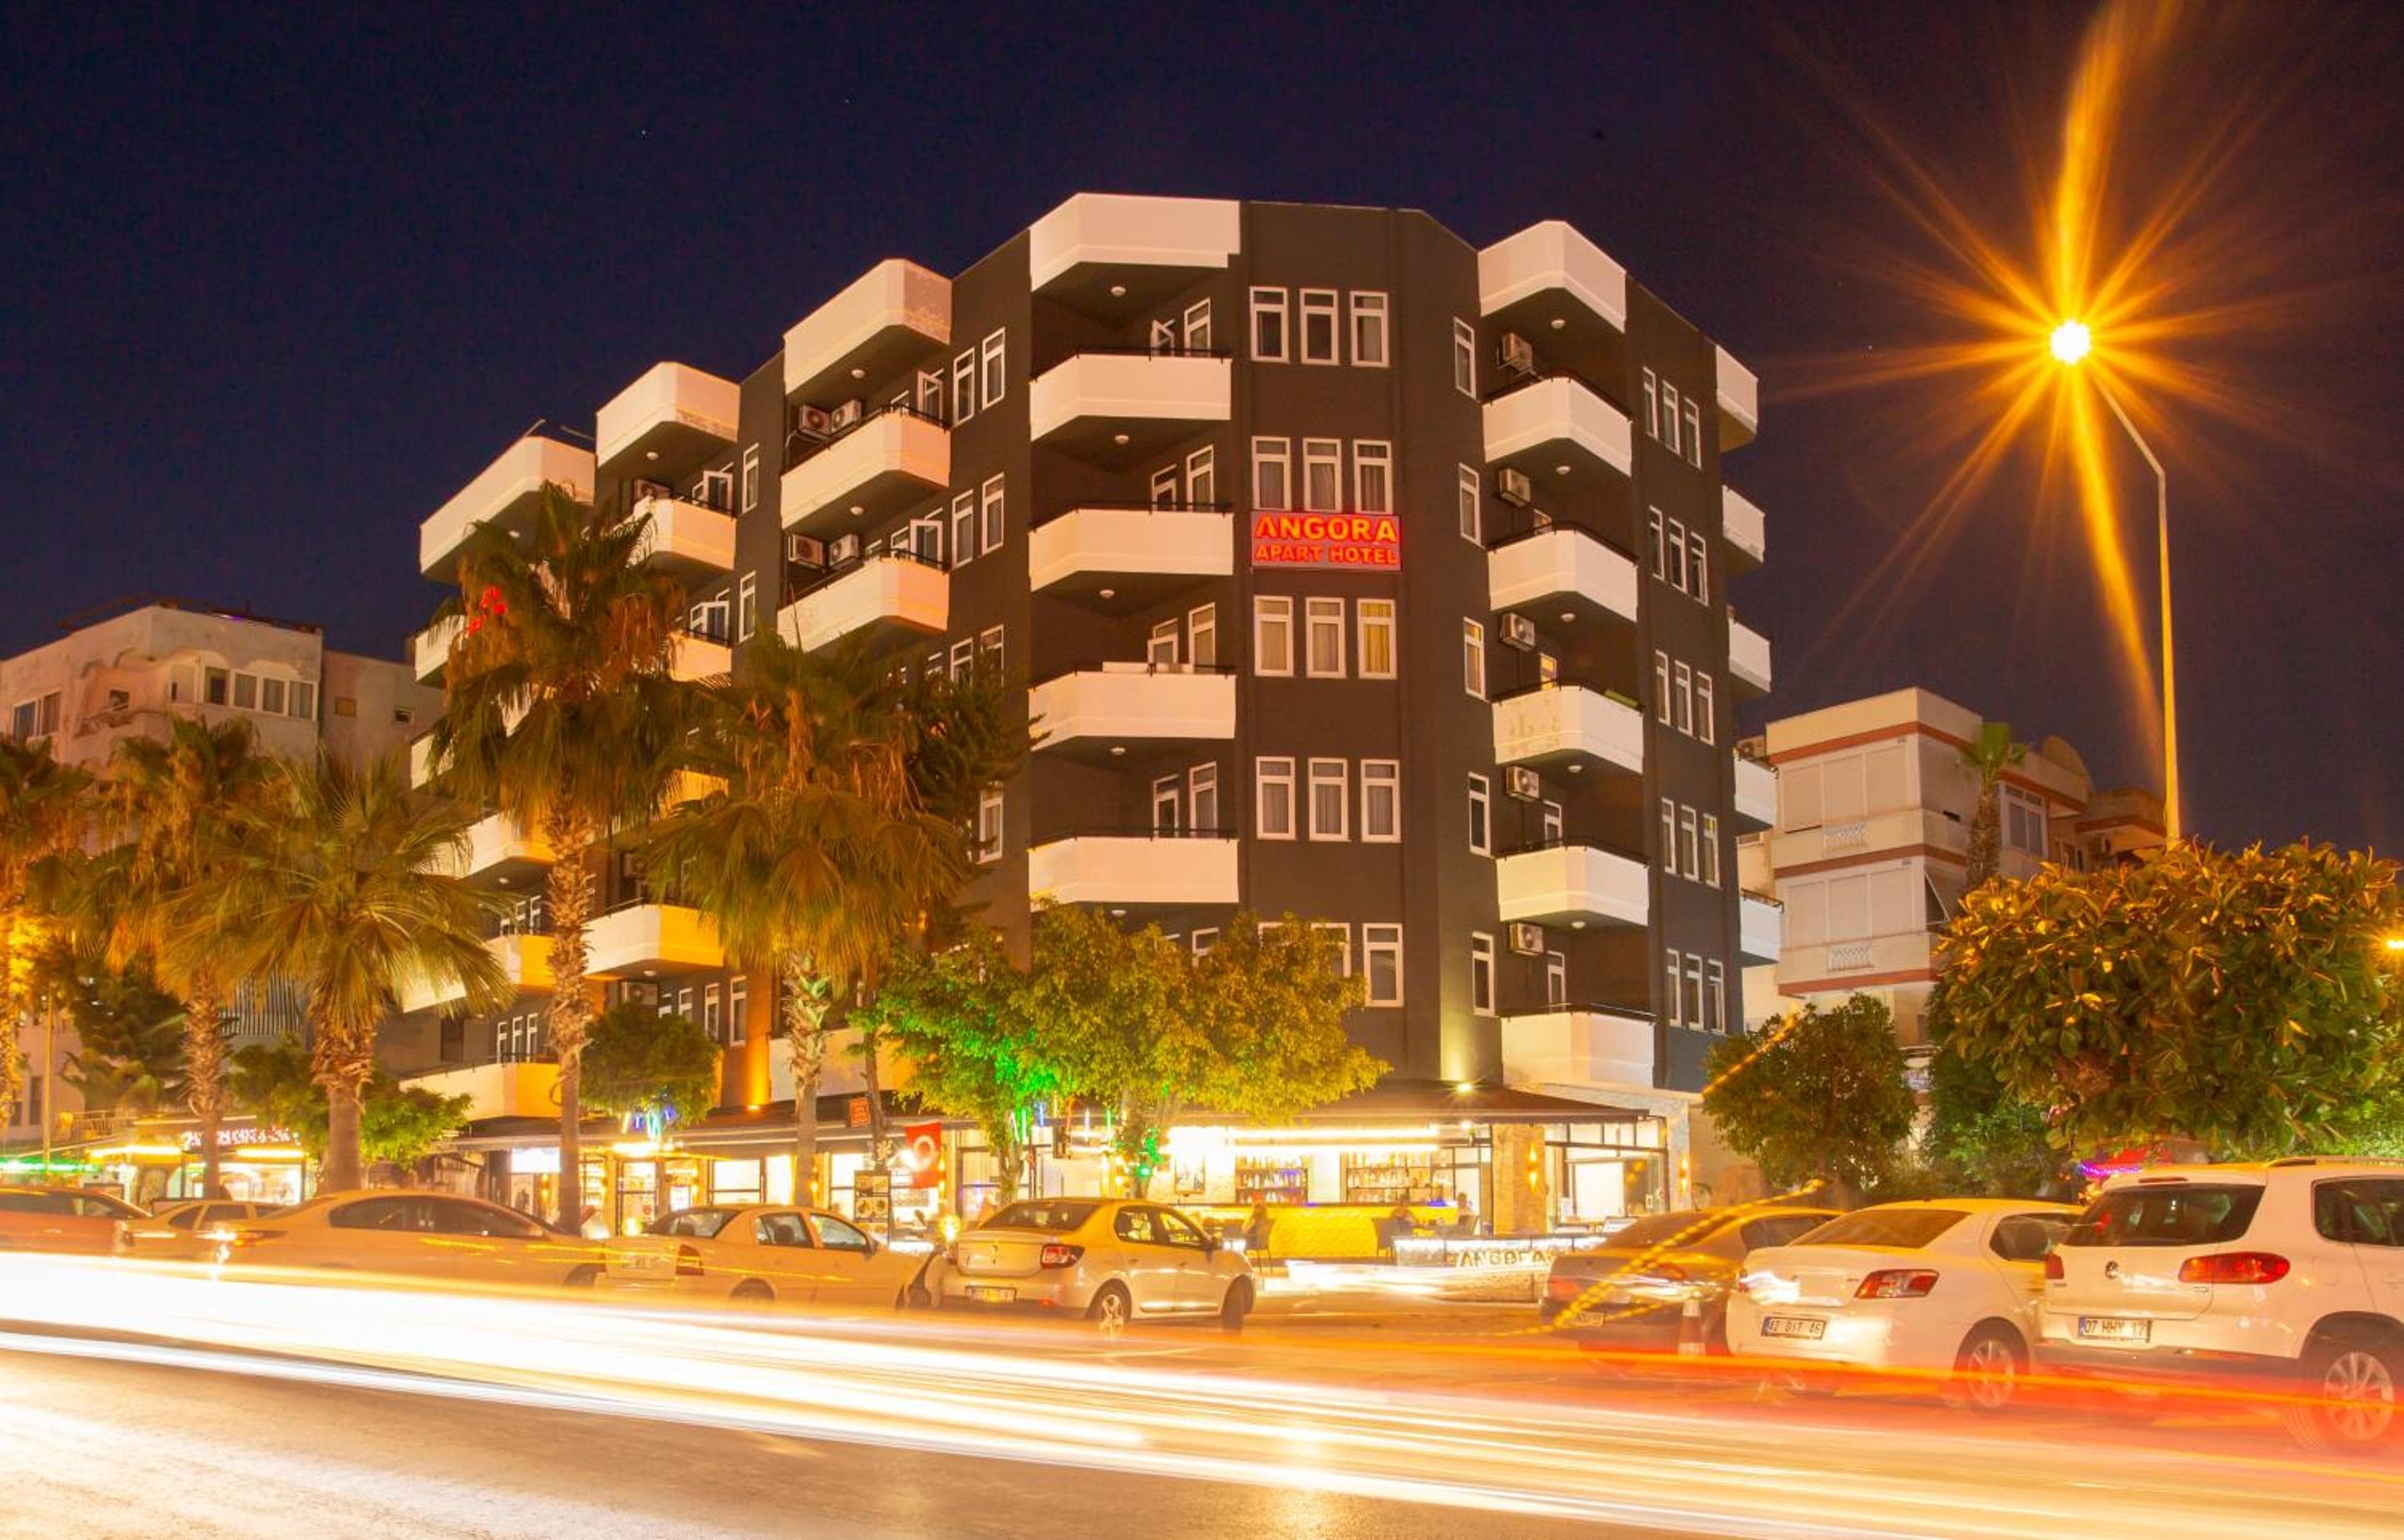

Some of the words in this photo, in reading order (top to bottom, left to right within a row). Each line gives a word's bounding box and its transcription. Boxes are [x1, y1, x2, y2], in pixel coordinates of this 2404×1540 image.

[1255, 514, 1398, 542] ANGORA
[1256, 544, 1322, 562] APART
[1329, 546, 1398, 565] HOTEL
